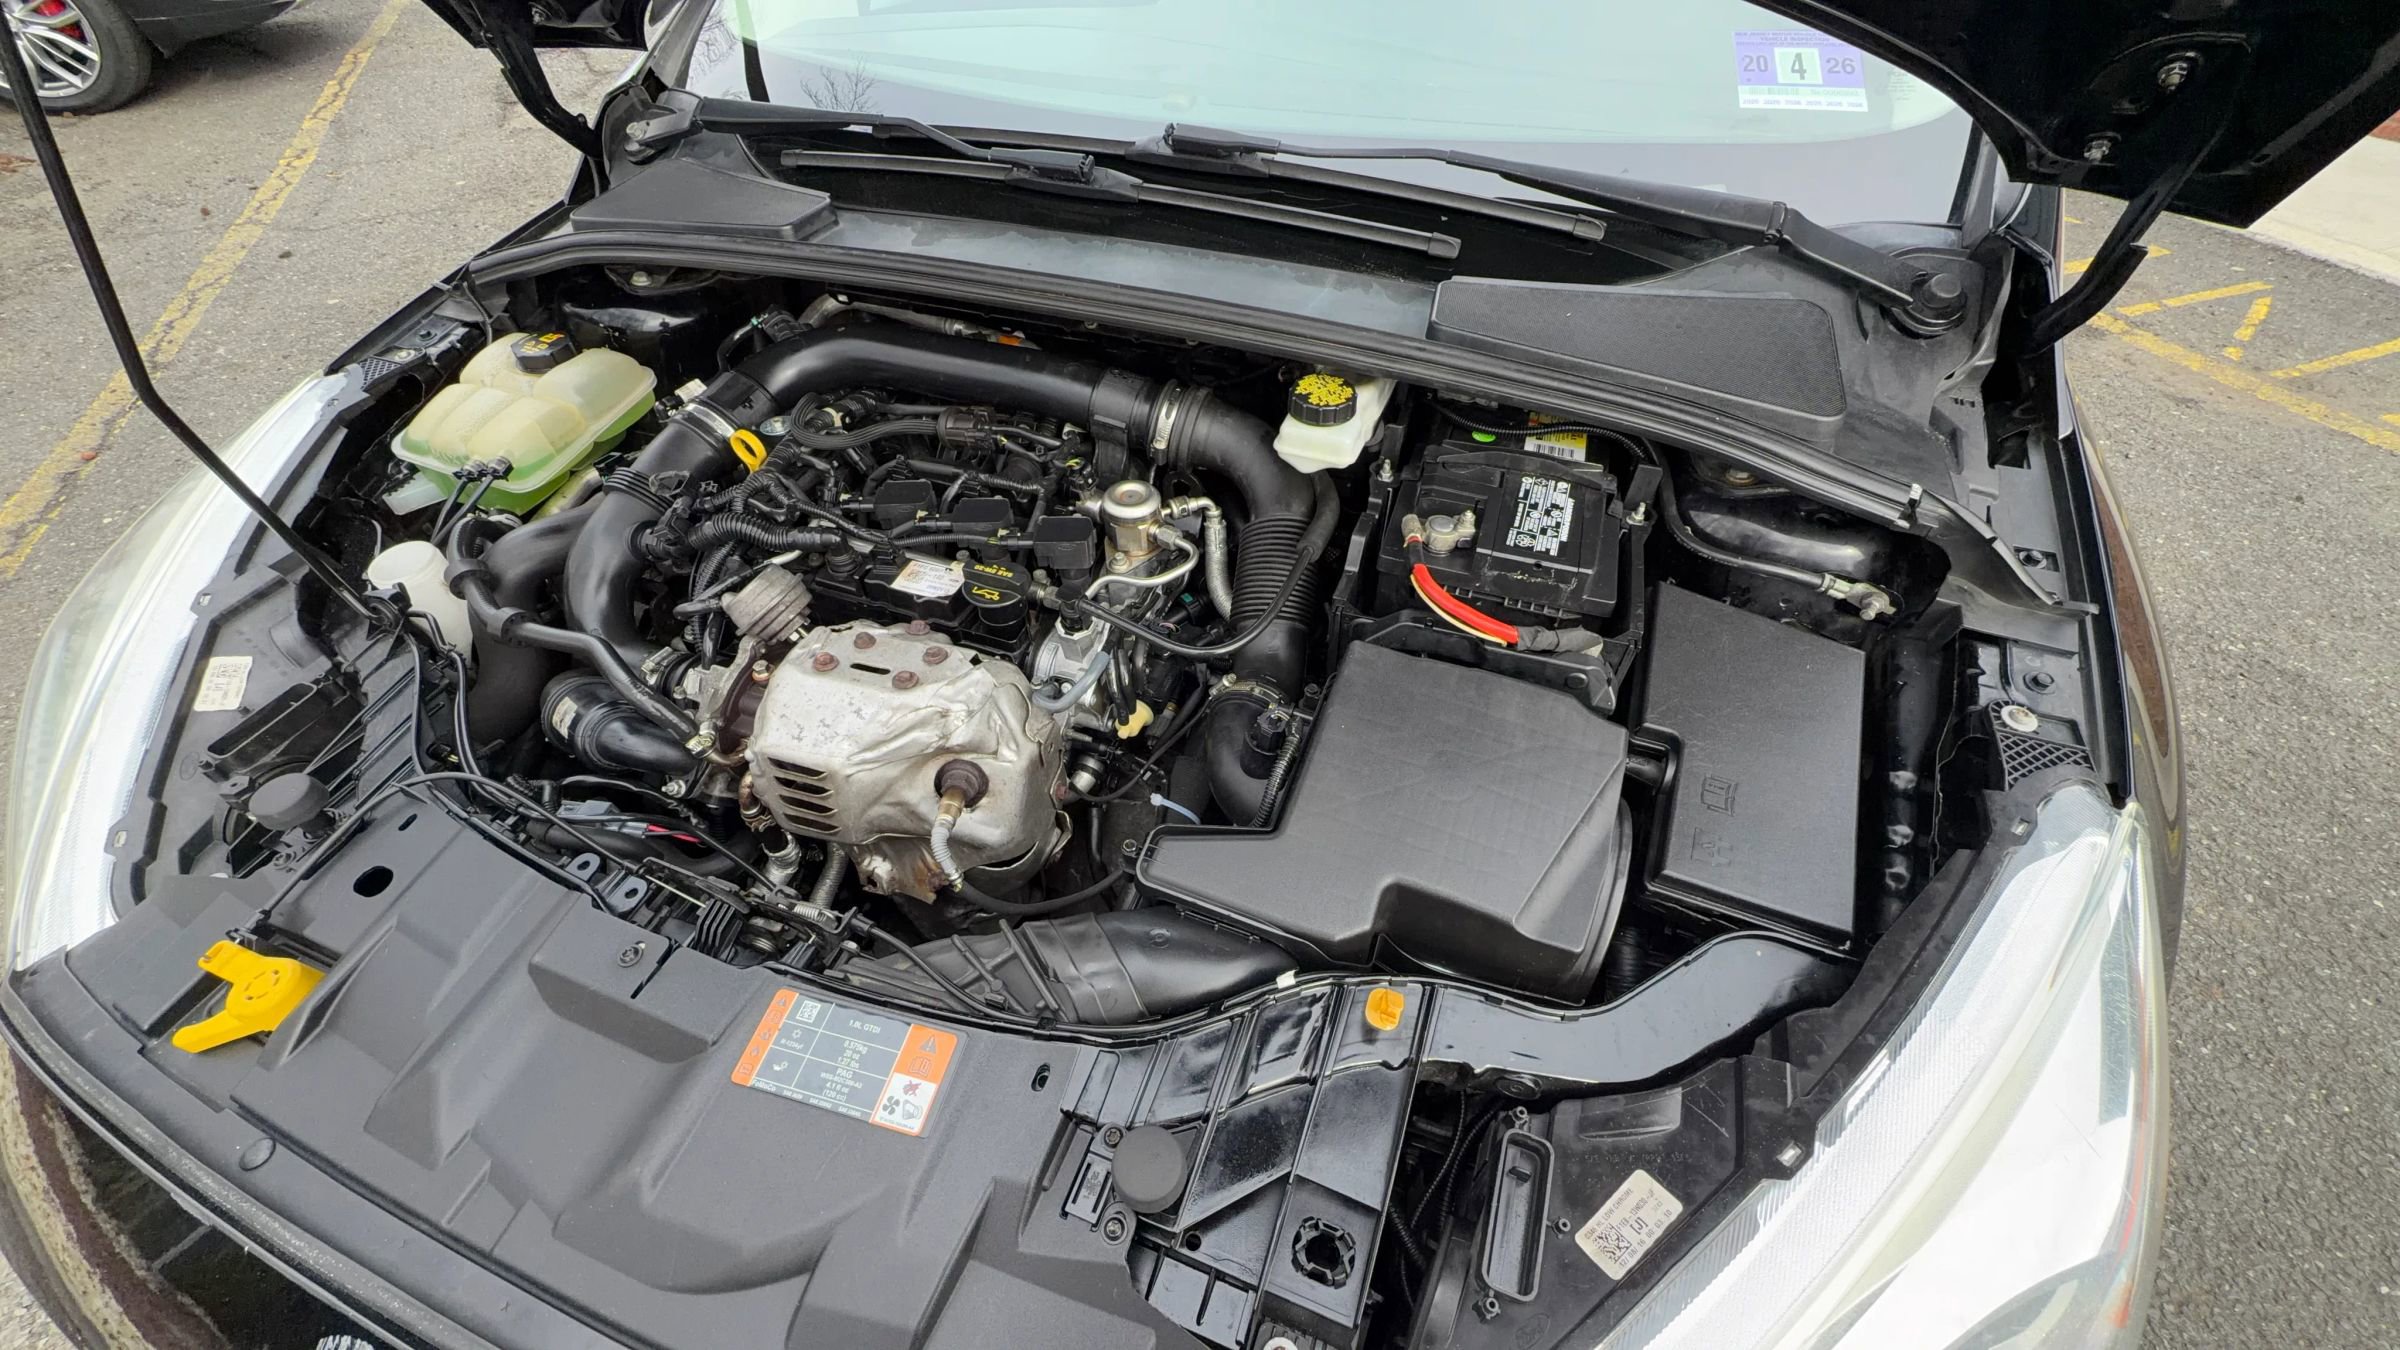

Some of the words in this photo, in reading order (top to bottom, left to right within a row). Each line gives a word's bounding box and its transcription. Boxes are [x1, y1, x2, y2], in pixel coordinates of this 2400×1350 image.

[1742, 55, 1769, 73] 20
[1791, 52, 1807, 80] 4
[1826, 57, 1856, 75] 26
[836, 1068, 853, 1078] PAG
[752, 1080, 777, 1092] FoMoCo
[1604, 1207, 1616, 1222] LOW
[1612, 1188, 1634, 1209] CHROME
